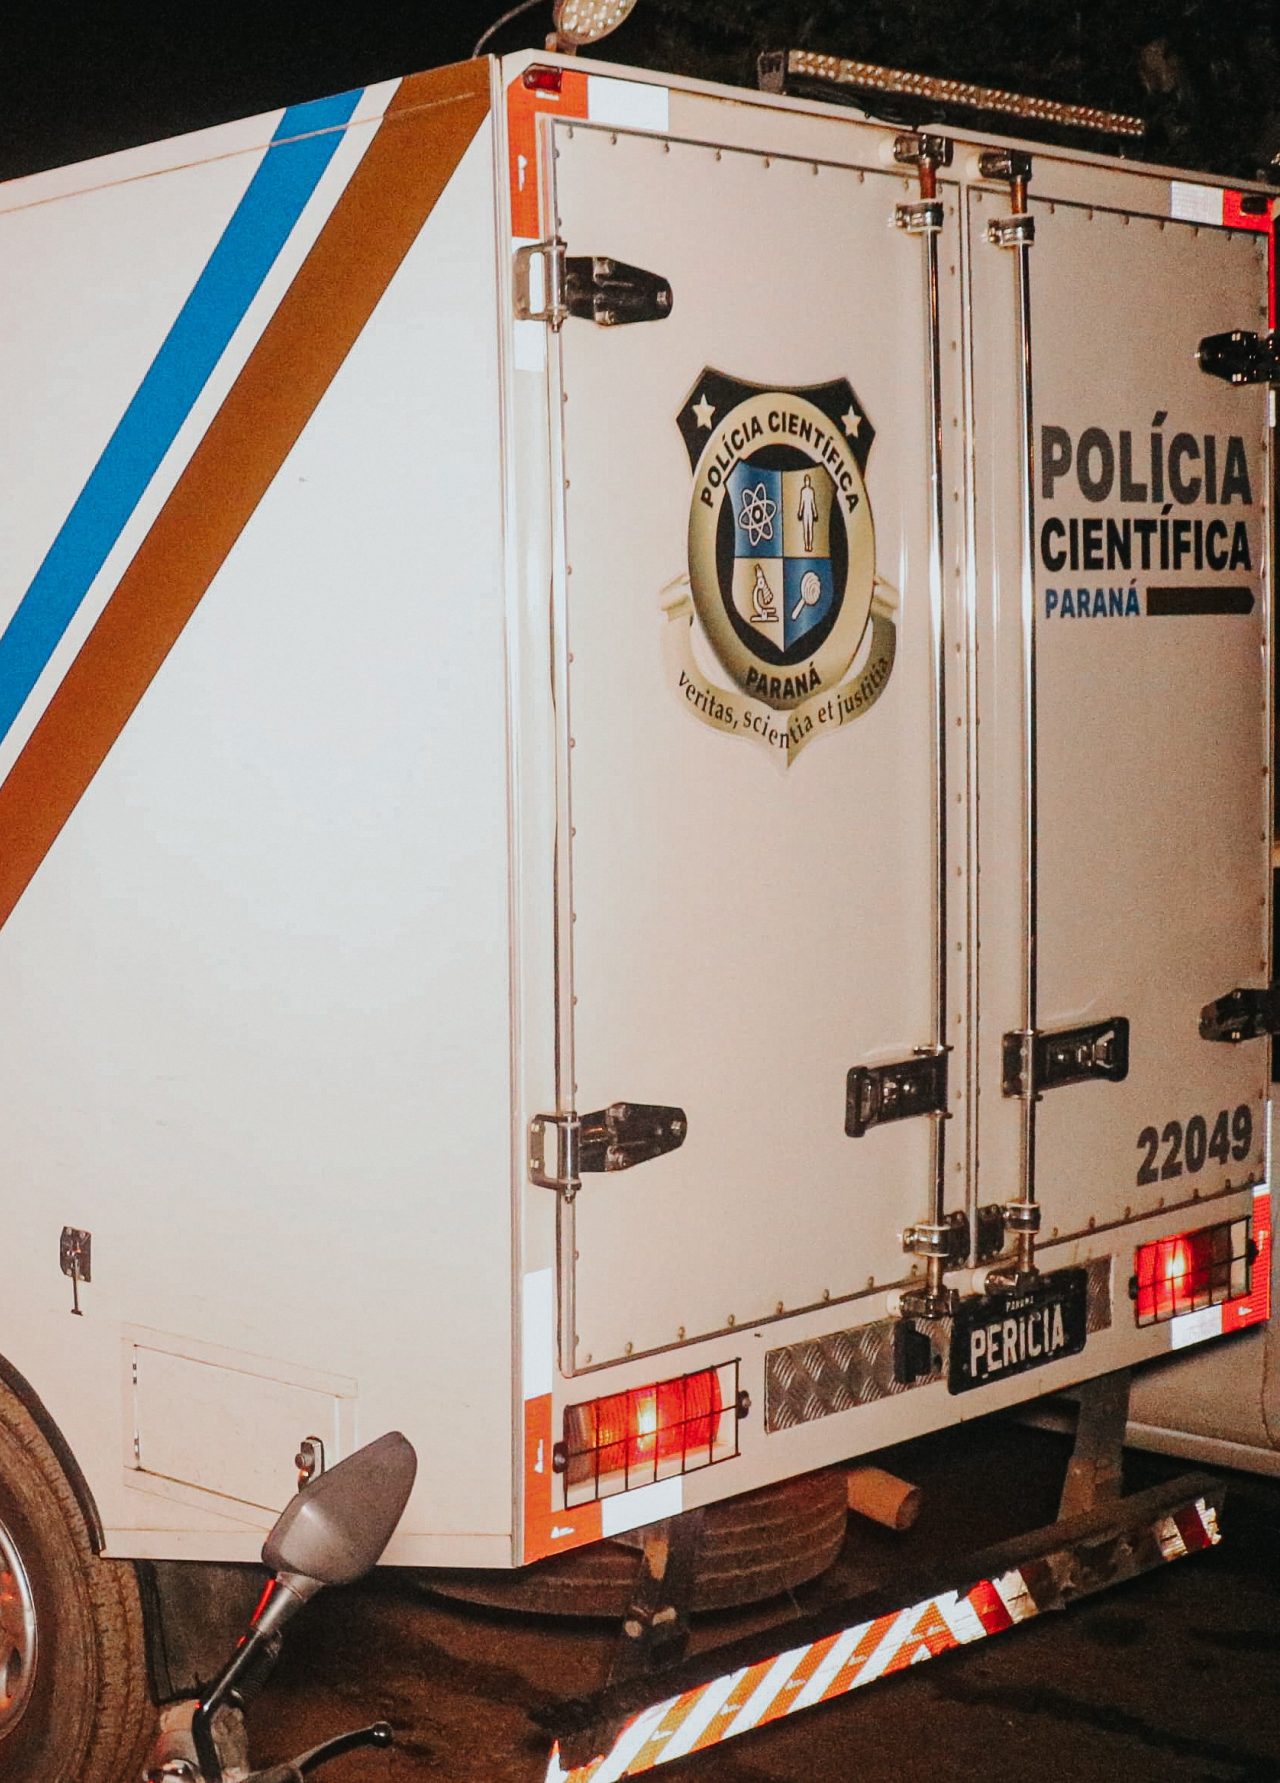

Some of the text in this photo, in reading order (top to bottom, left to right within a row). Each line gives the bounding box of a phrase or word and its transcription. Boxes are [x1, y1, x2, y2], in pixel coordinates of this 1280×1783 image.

[700, 410, 859, 514] POLÍCIA CIENTÍFICA
[1041, 410, 1253, 505] POLÍCIA
[1040, 503, 1252, 572] CIENTÍFICA
[1044, 578, 1140, 619] PARANÁ
[742, 711, 813, 750] scientia
[817, 701, 835, 724] et
[837, 657, 890, 725] justitia
[745, 662, 822, 699] PARANÁ
[1136, 1103, 1253, 1187] 22049
